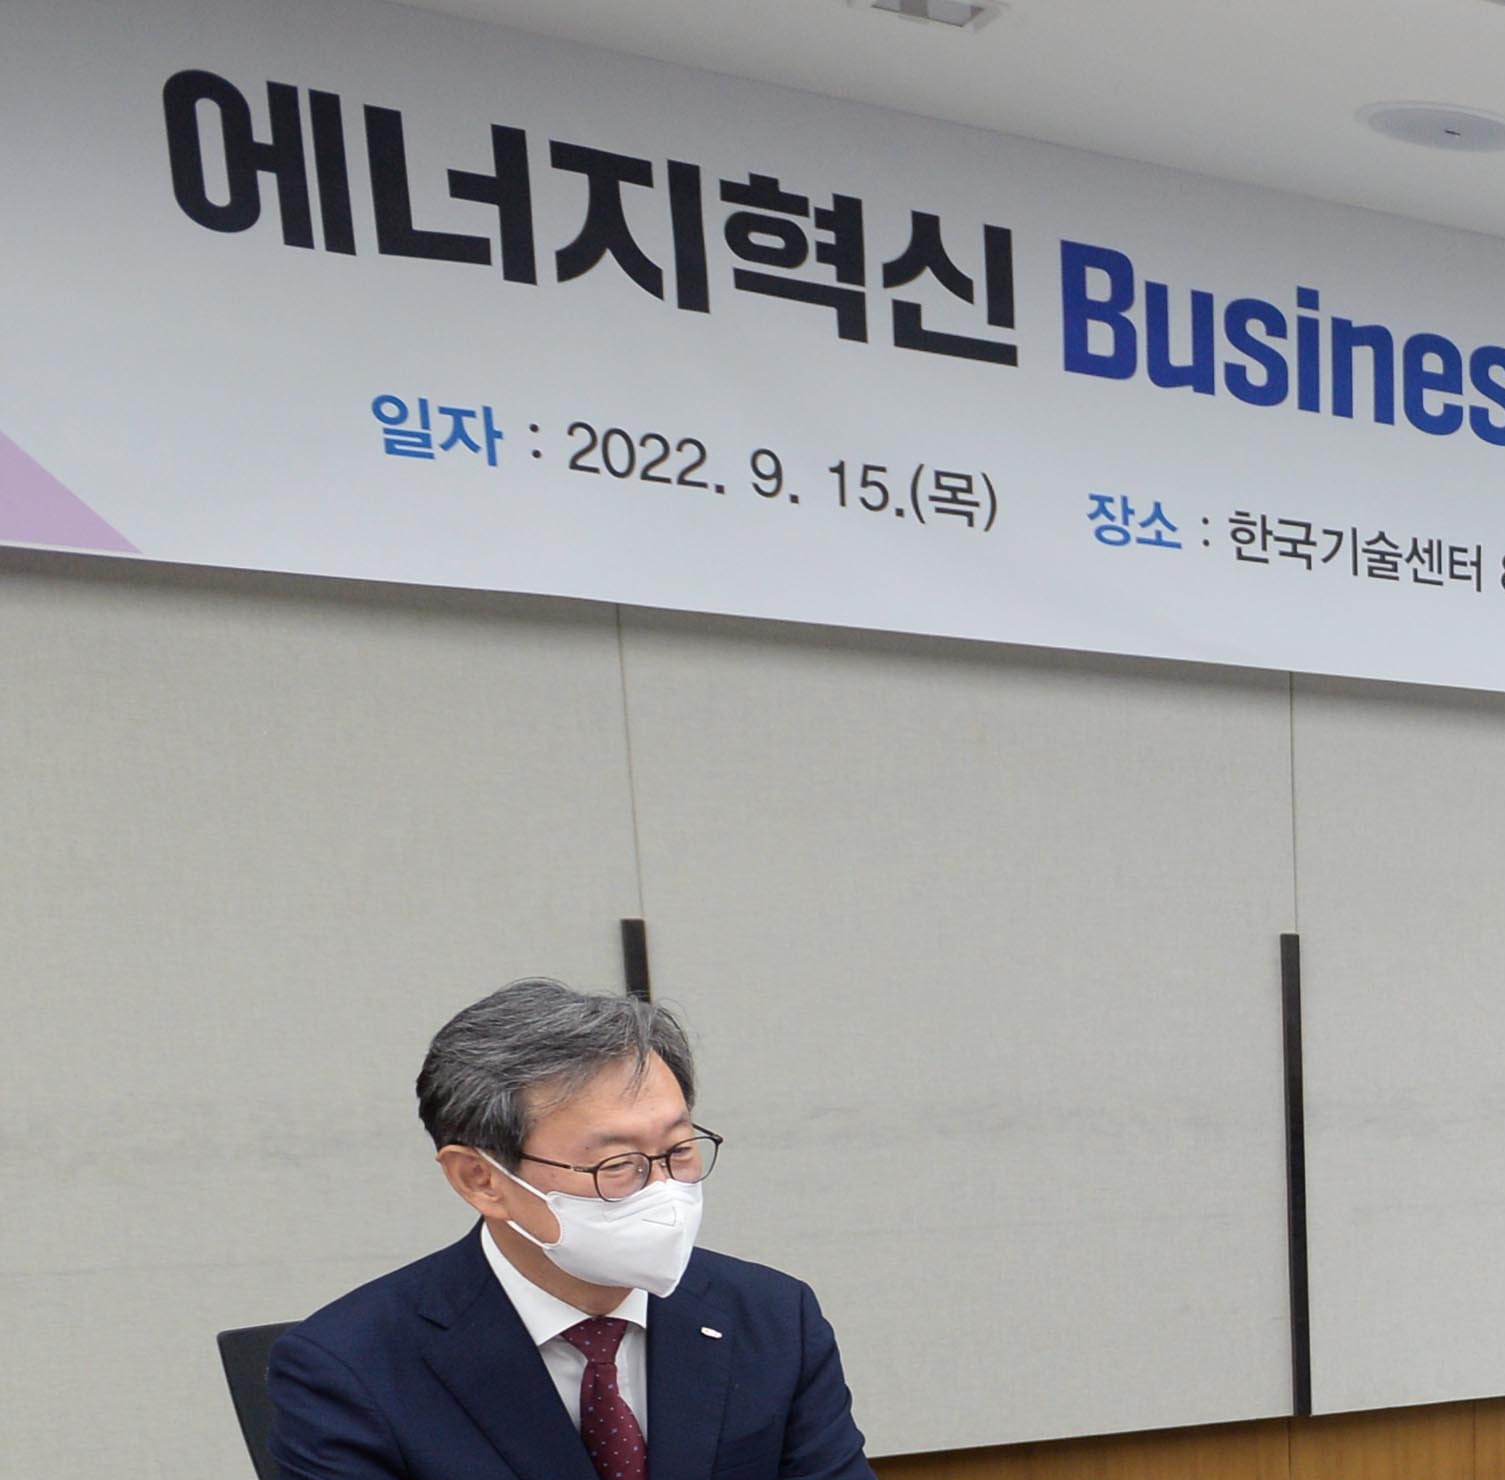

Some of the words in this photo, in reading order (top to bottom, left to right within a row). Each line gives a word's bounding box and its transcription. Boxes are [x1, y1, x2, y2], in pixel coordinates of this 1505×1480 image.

[162, 69, 1019, 368] 에너지혁신
[371, 394, 504, 467] 일자
[566, 420, 726, 496] 2022.
[750, 448, 800, 505] 9.
[828, 460, 998, 532] 15.(목)
[1086, 493, 1182, 550] 장소
[1228, 510, 1483, 593] 한국기술센터
